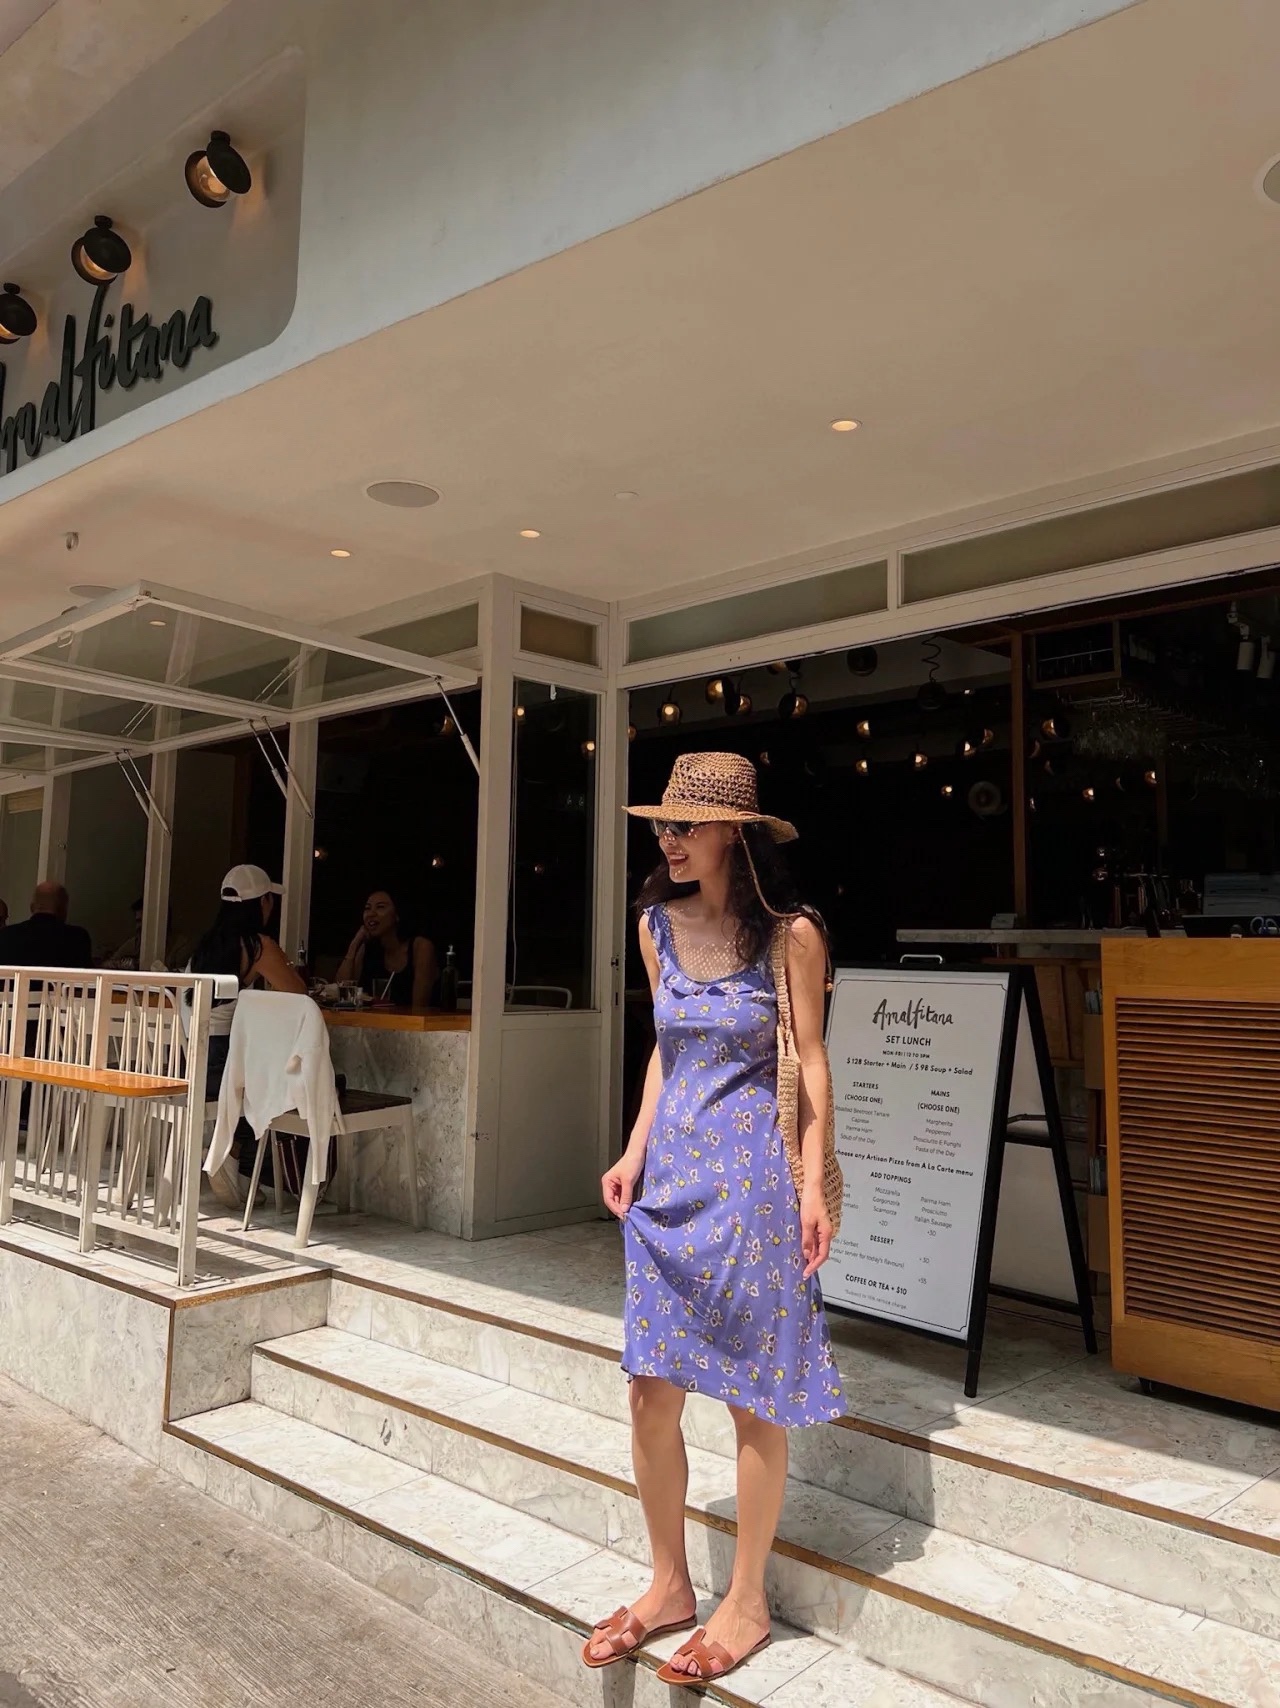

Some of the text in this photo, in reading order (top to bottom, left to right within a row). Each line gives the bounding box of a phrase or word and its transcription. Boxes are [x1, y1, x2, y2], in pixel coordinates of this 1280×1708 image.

[0, 283, 219, 474] malfitana
[872, 998, 954, 1030] Amalfitana
[886, 1035, 931, 1046] SET LUNCH
[930, 1065, 946, 1073] Soup
[853, 1081, 878, 1089] STARTERS
[845, 1094, 868, 1102] (CHOOSE
[918, 1103, 960, 1114] (CHOOSE ONE)
[866, 1153, 887, 1162] Artisan
[889, 1157, 905, 1165] Pizza
[906, 1159, 920, 1168] from
[937, 1164, 954, 1173] Carte
[884, 1174, 911, 1184] TOPPINGS
[870, 1235, 894, 1245] DESSERT
[845, 1274, 866, 1285] COFFEE
[878, 1282, 889, 1291] TEA
[896, 1286, 907, 1295] $10
